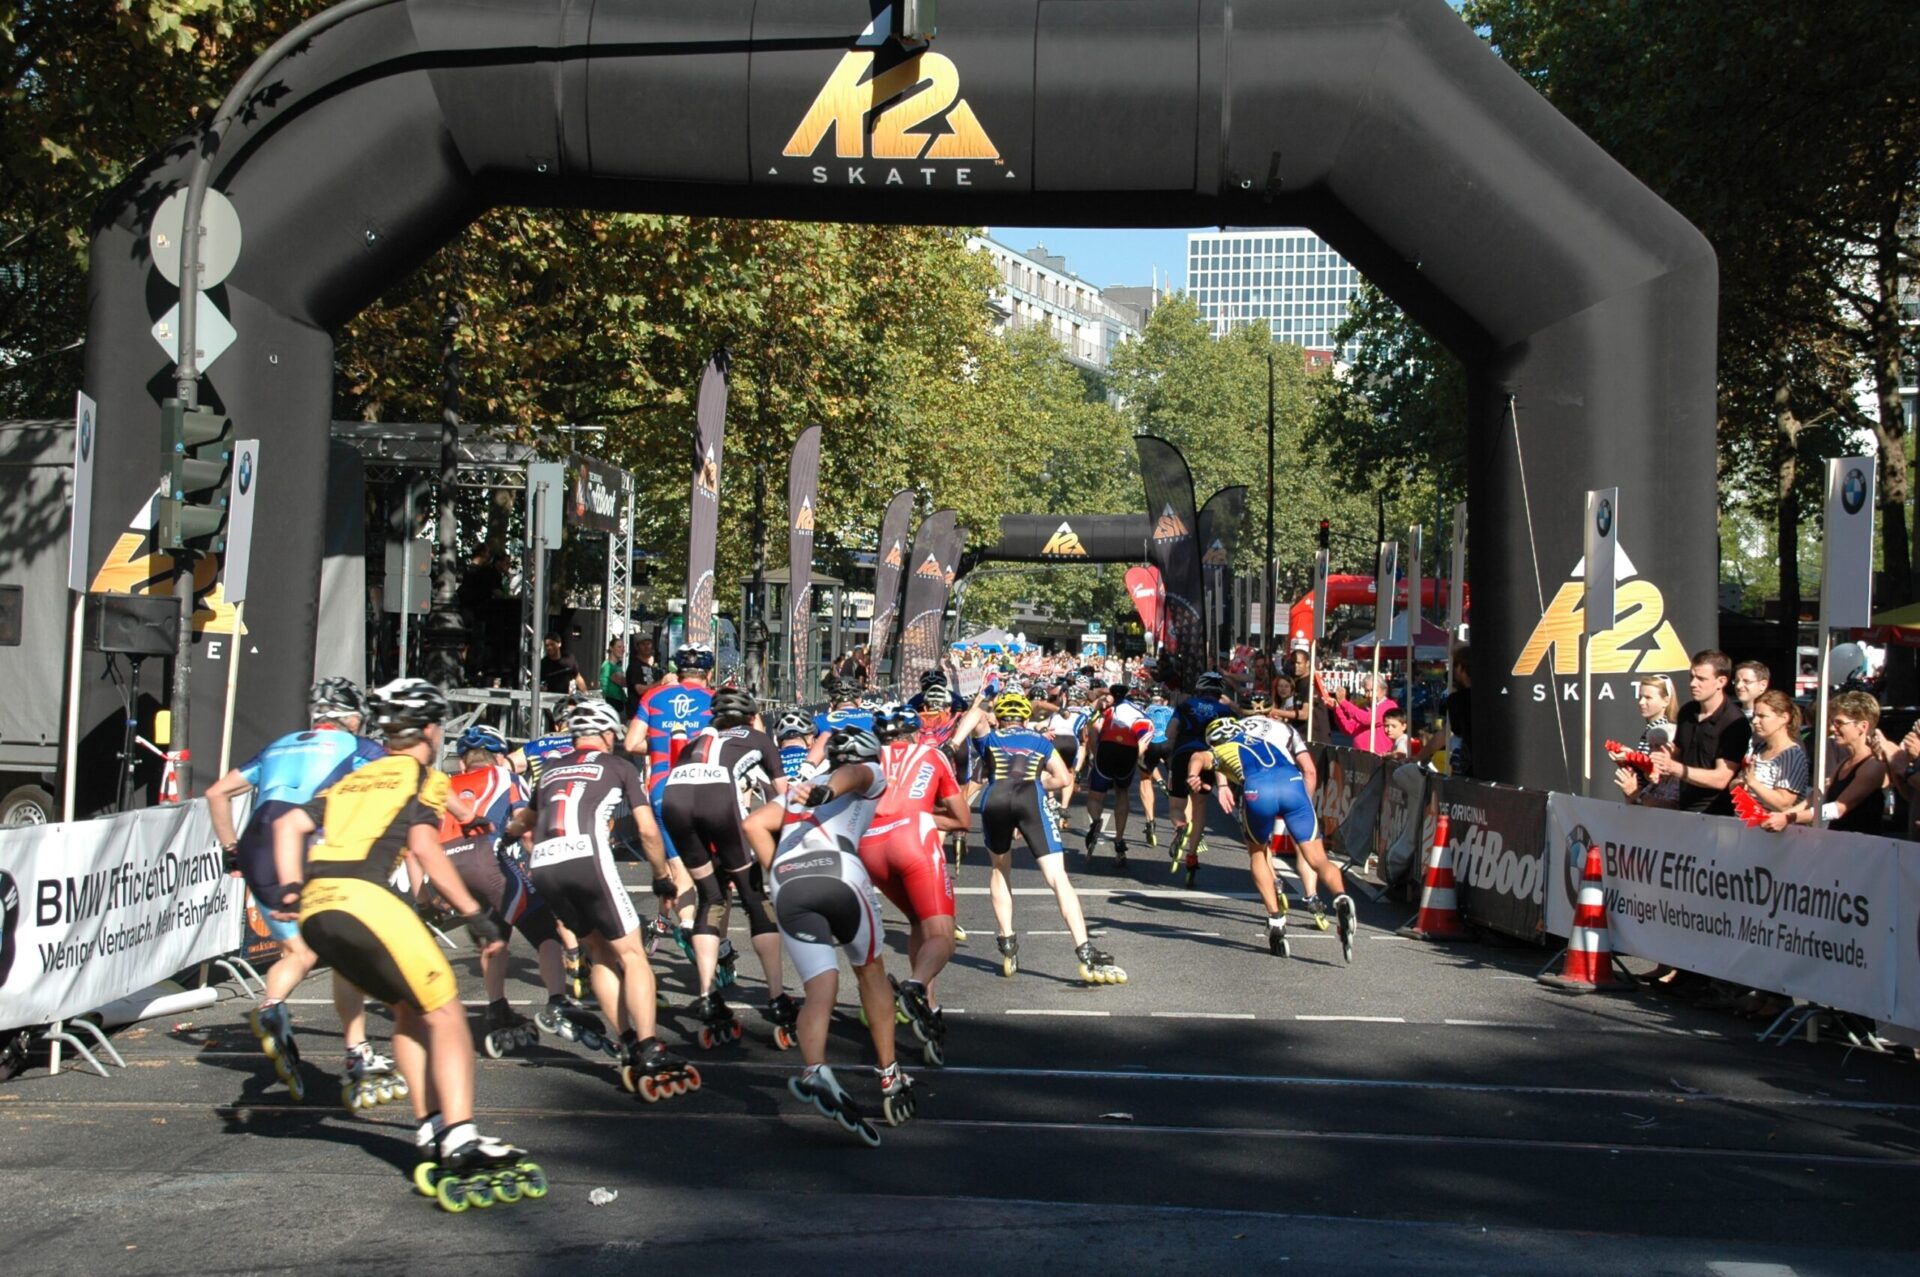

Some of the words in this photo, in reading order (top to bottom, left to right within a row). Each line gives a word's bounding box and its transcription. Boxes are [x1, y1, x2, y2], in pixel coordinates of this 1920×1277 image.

[782, 51, 1000, 159] K2
[812, 166, 973, 186] SKATE
[1041, 532, 1087, 555] K2
[1511, 579, 1692, 676] K2
[1532, 682, 1641, 702] SKAT
[673, 768, 721, 779] RACING
[1451, 804, 1488, 826] ORIGINAL
[533, 840, 586, 860] RACING
[1604, 841, 1658, 886] BMW
[1660, 851, 1870, 927] EfficientDynamics
[36, 872, 107, 928] BMW
[1605, 887, 1657, 925] Weniger
[1659, 899, 1734, 940] Verbrauch.
[1737, 915, 1774, 948] Mehr
[1776, 923, 1868, 969] Fahrfreude.
